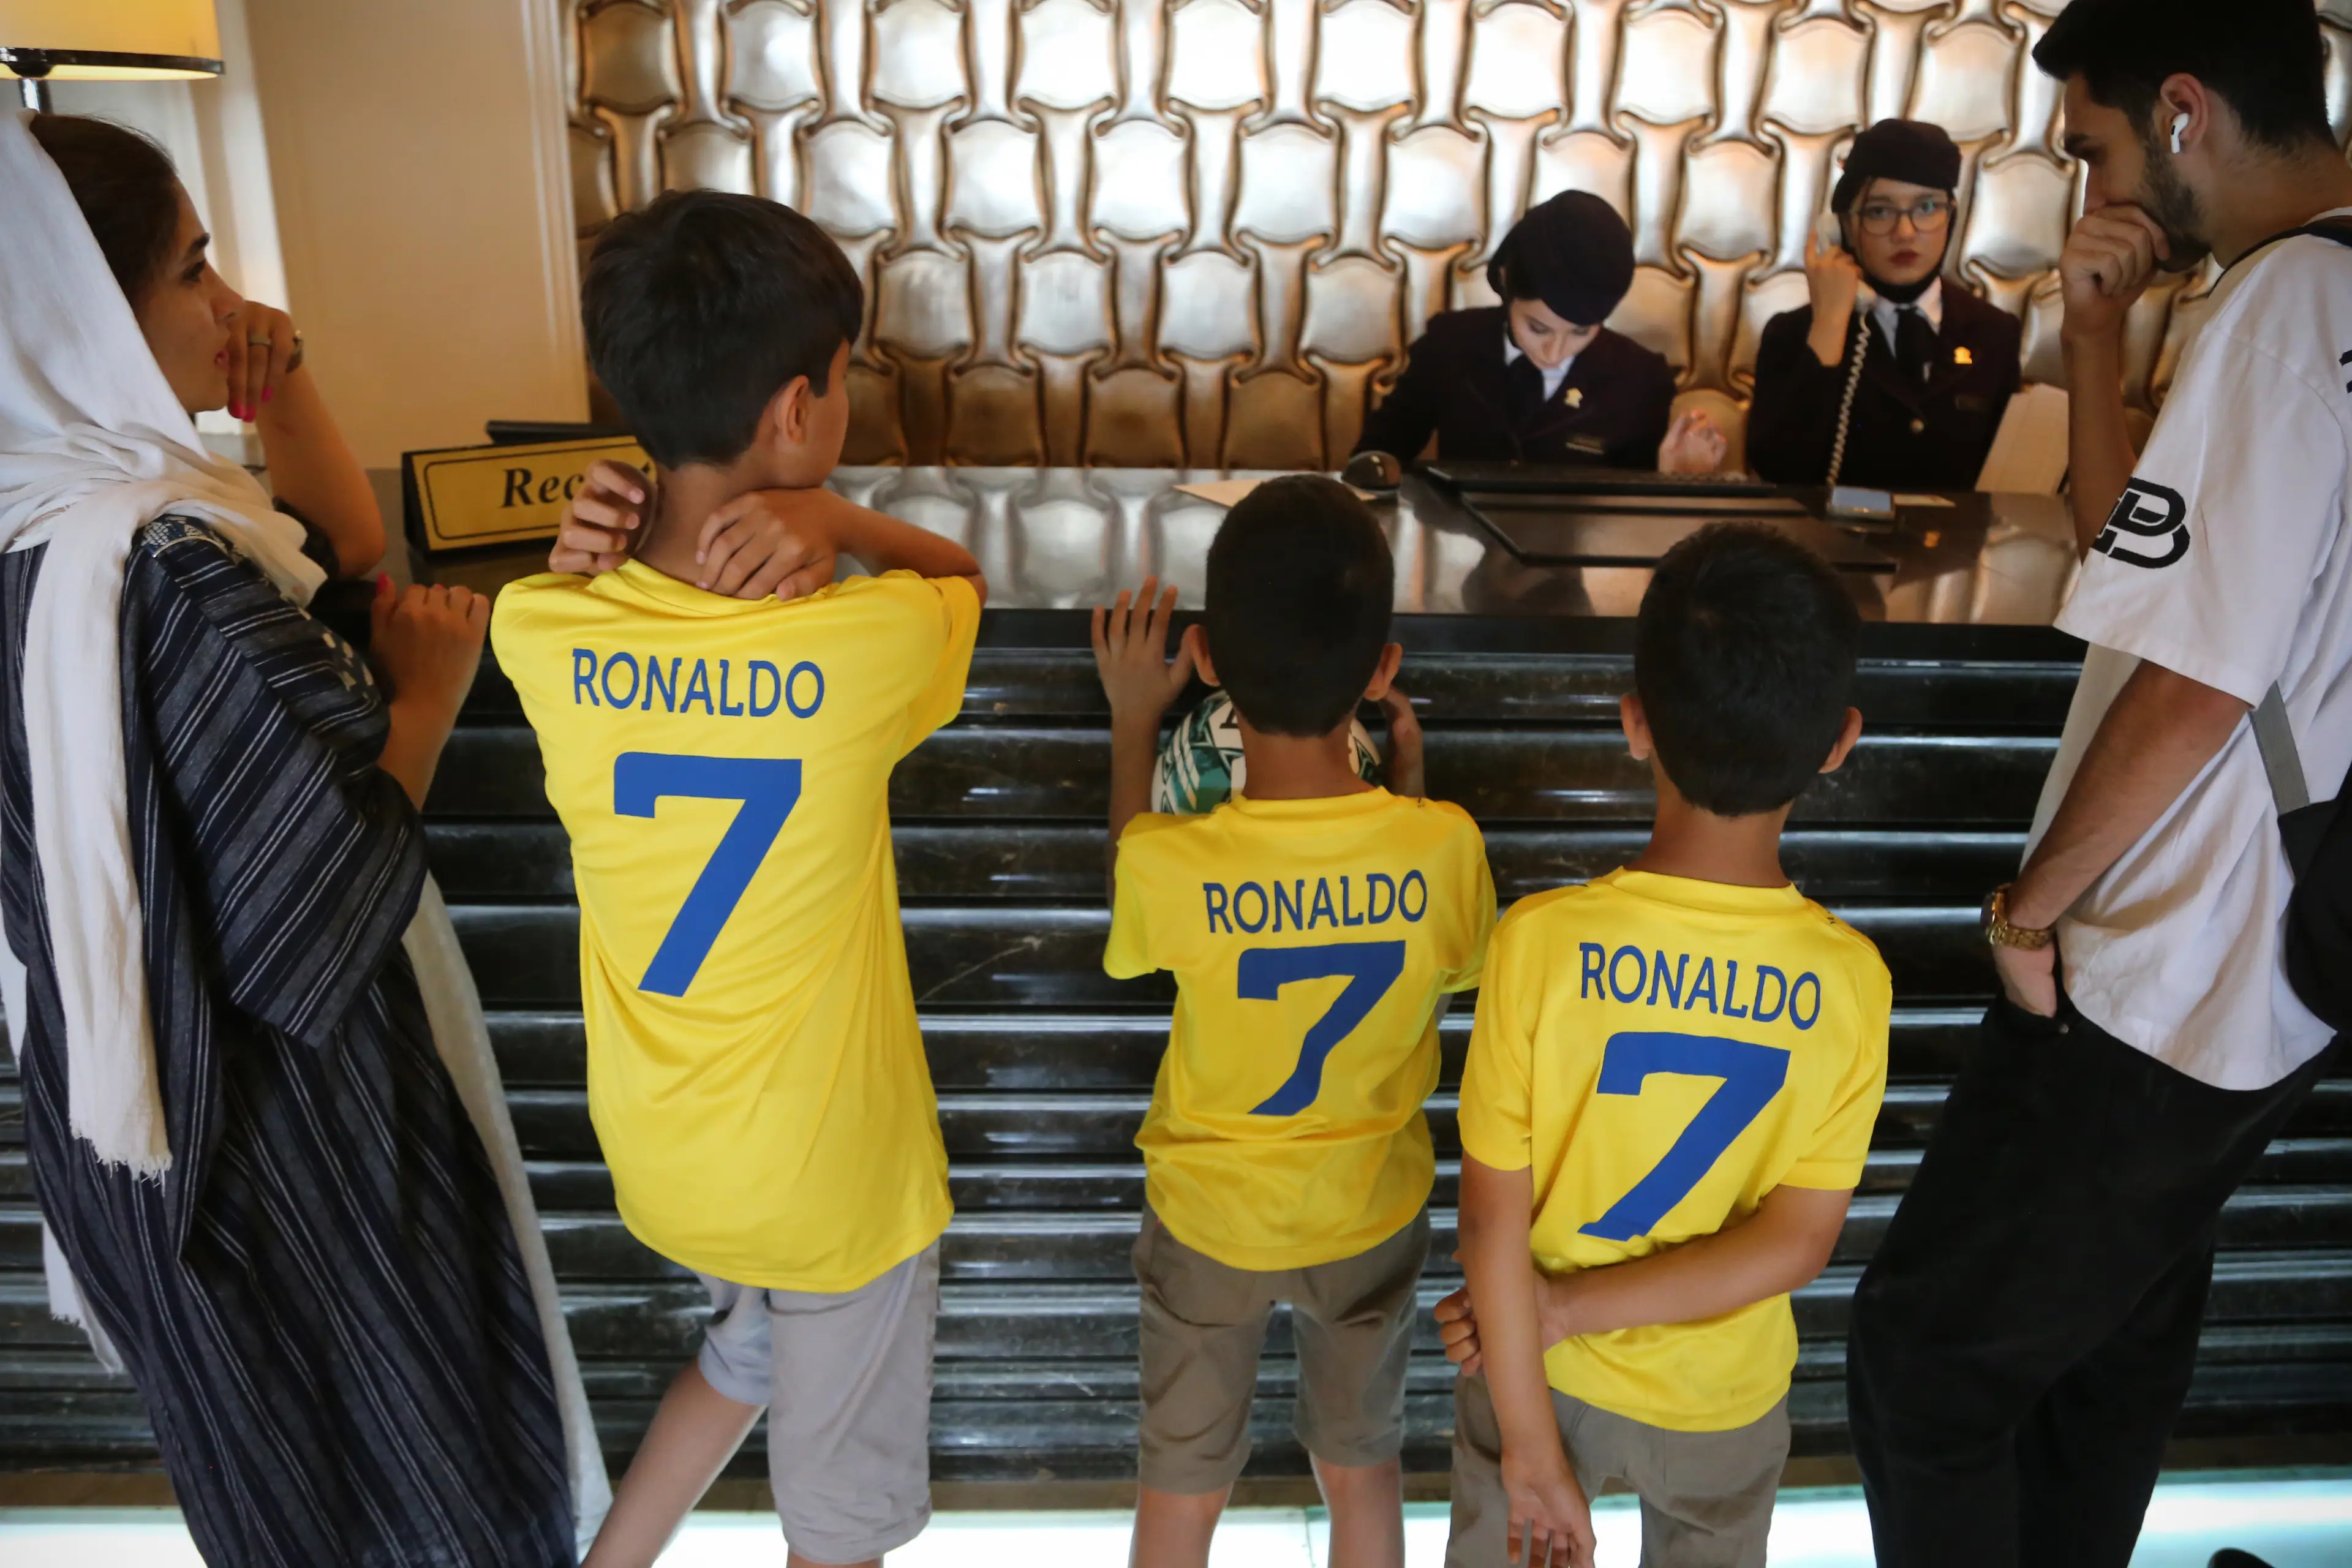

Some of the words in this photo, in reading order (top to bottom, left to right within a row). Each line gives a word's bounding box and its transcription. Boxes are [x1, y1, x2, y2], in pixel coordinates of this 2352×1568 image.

[573, 649, 824, 718] RONALDO
[614, 752, 802, 997] 7
[1204, 870, 1427, 934] RONALDO
[1238, 940, 1405, 1116] 7
[1580, 942, 1820, 1030] RONALDO
[1578, 1031, 1791, 1242] 7
